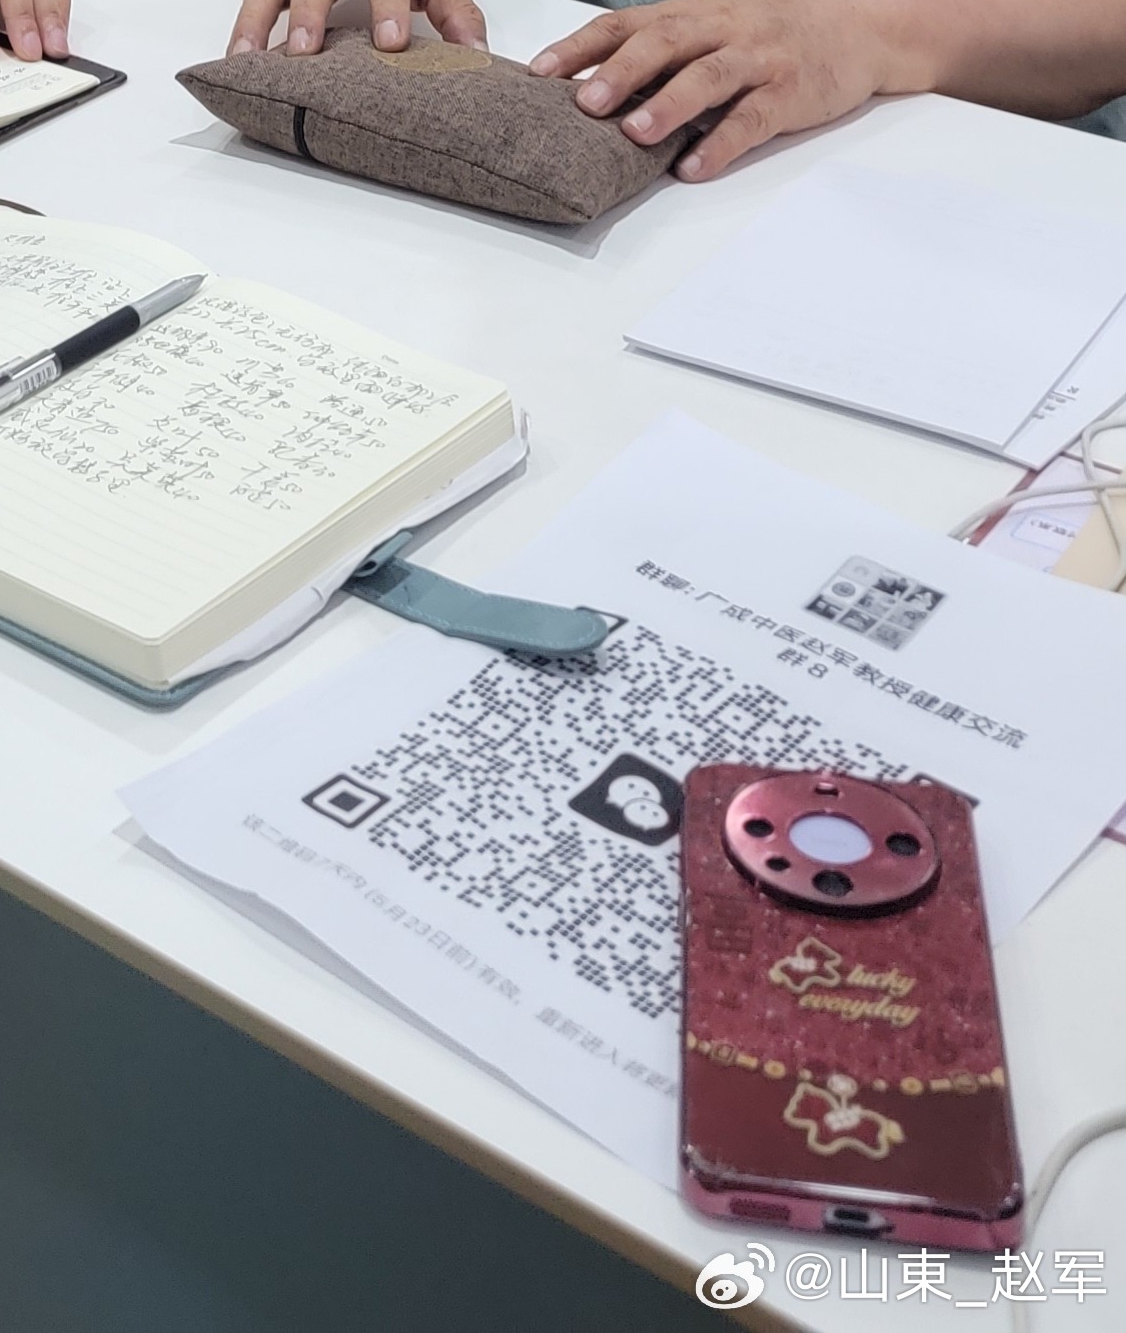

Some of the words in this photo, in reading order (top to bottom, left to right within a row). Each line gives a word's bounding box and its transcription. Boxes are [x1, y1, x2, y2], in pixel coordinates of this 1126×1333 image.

[777, 648, 829, 679] 群8
[847, 963, 917, 996] lucky
[799, 990, 922, 1026] everyday
